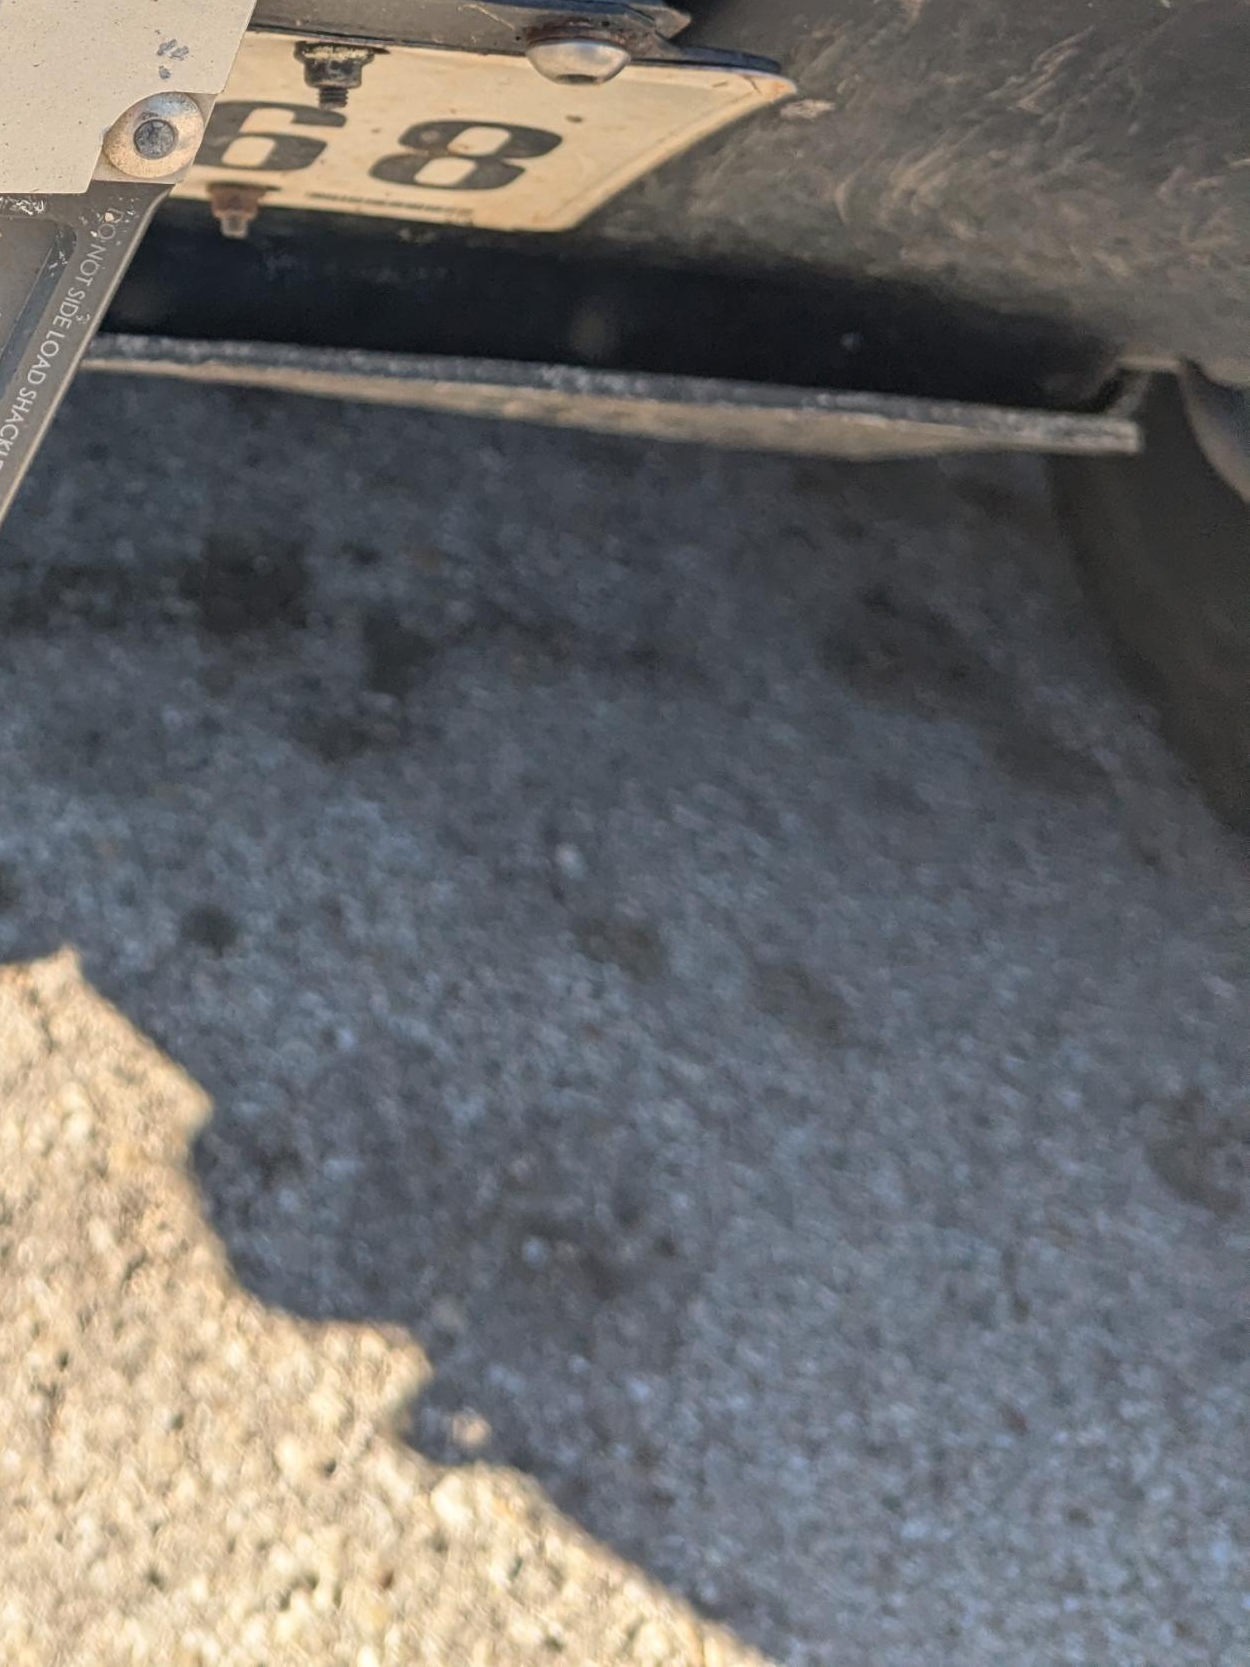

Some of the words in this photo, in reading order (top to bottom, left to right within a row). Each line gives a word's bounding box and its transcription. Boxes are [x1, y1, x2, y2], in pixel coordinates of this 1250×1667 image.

[74, 243, 108, 287] NOT
[52, 287, 85, 330] SIDE
[26, 329, 65, 385] LOAD
